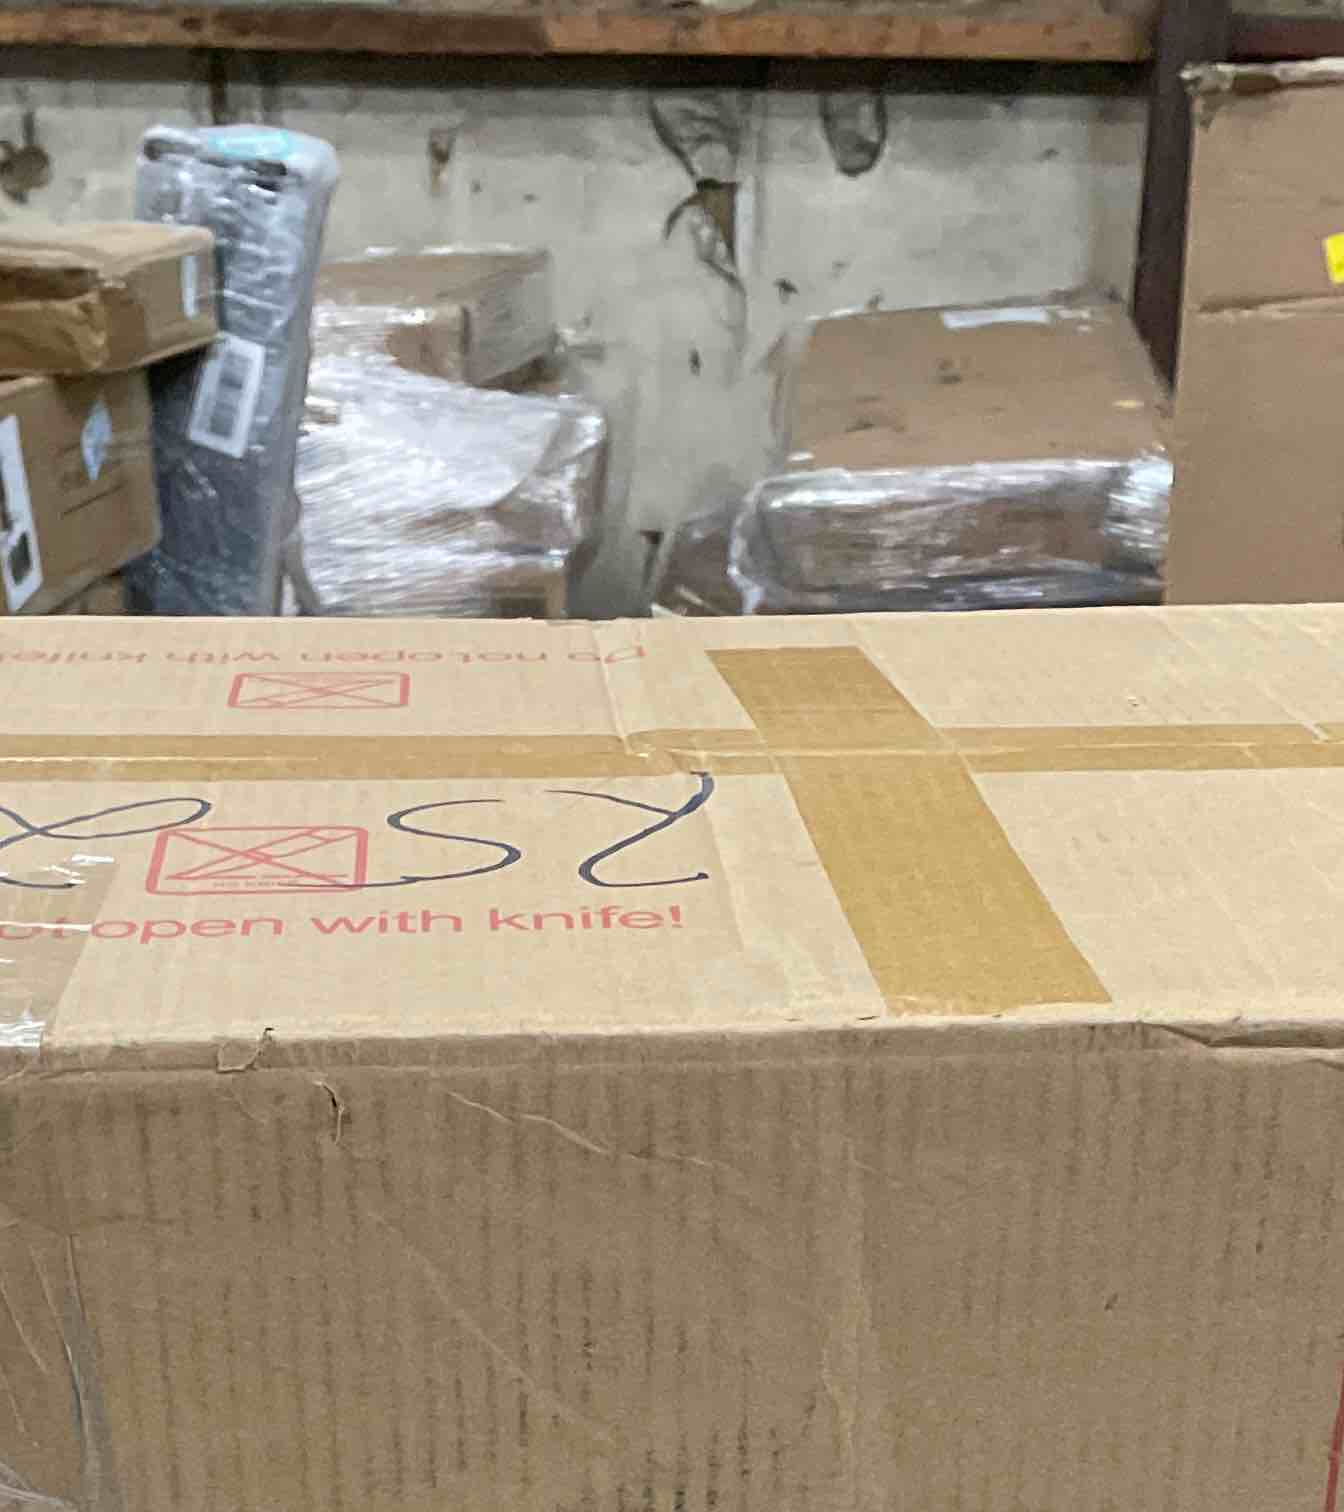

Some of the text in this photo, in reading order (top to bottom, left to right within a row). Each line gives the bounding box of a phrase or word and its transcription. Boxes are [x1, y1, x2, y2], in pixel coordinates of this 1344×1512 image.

[163, 649, 282, 664] with
[299, 648, 443, 665] open
[452, 648, 547, 664] not
[567, 645, 647, 666] Do
[89, 915, 285, 946] open
[311, 909, 464, 935] with
[488, 904, 685, 932] knife!
